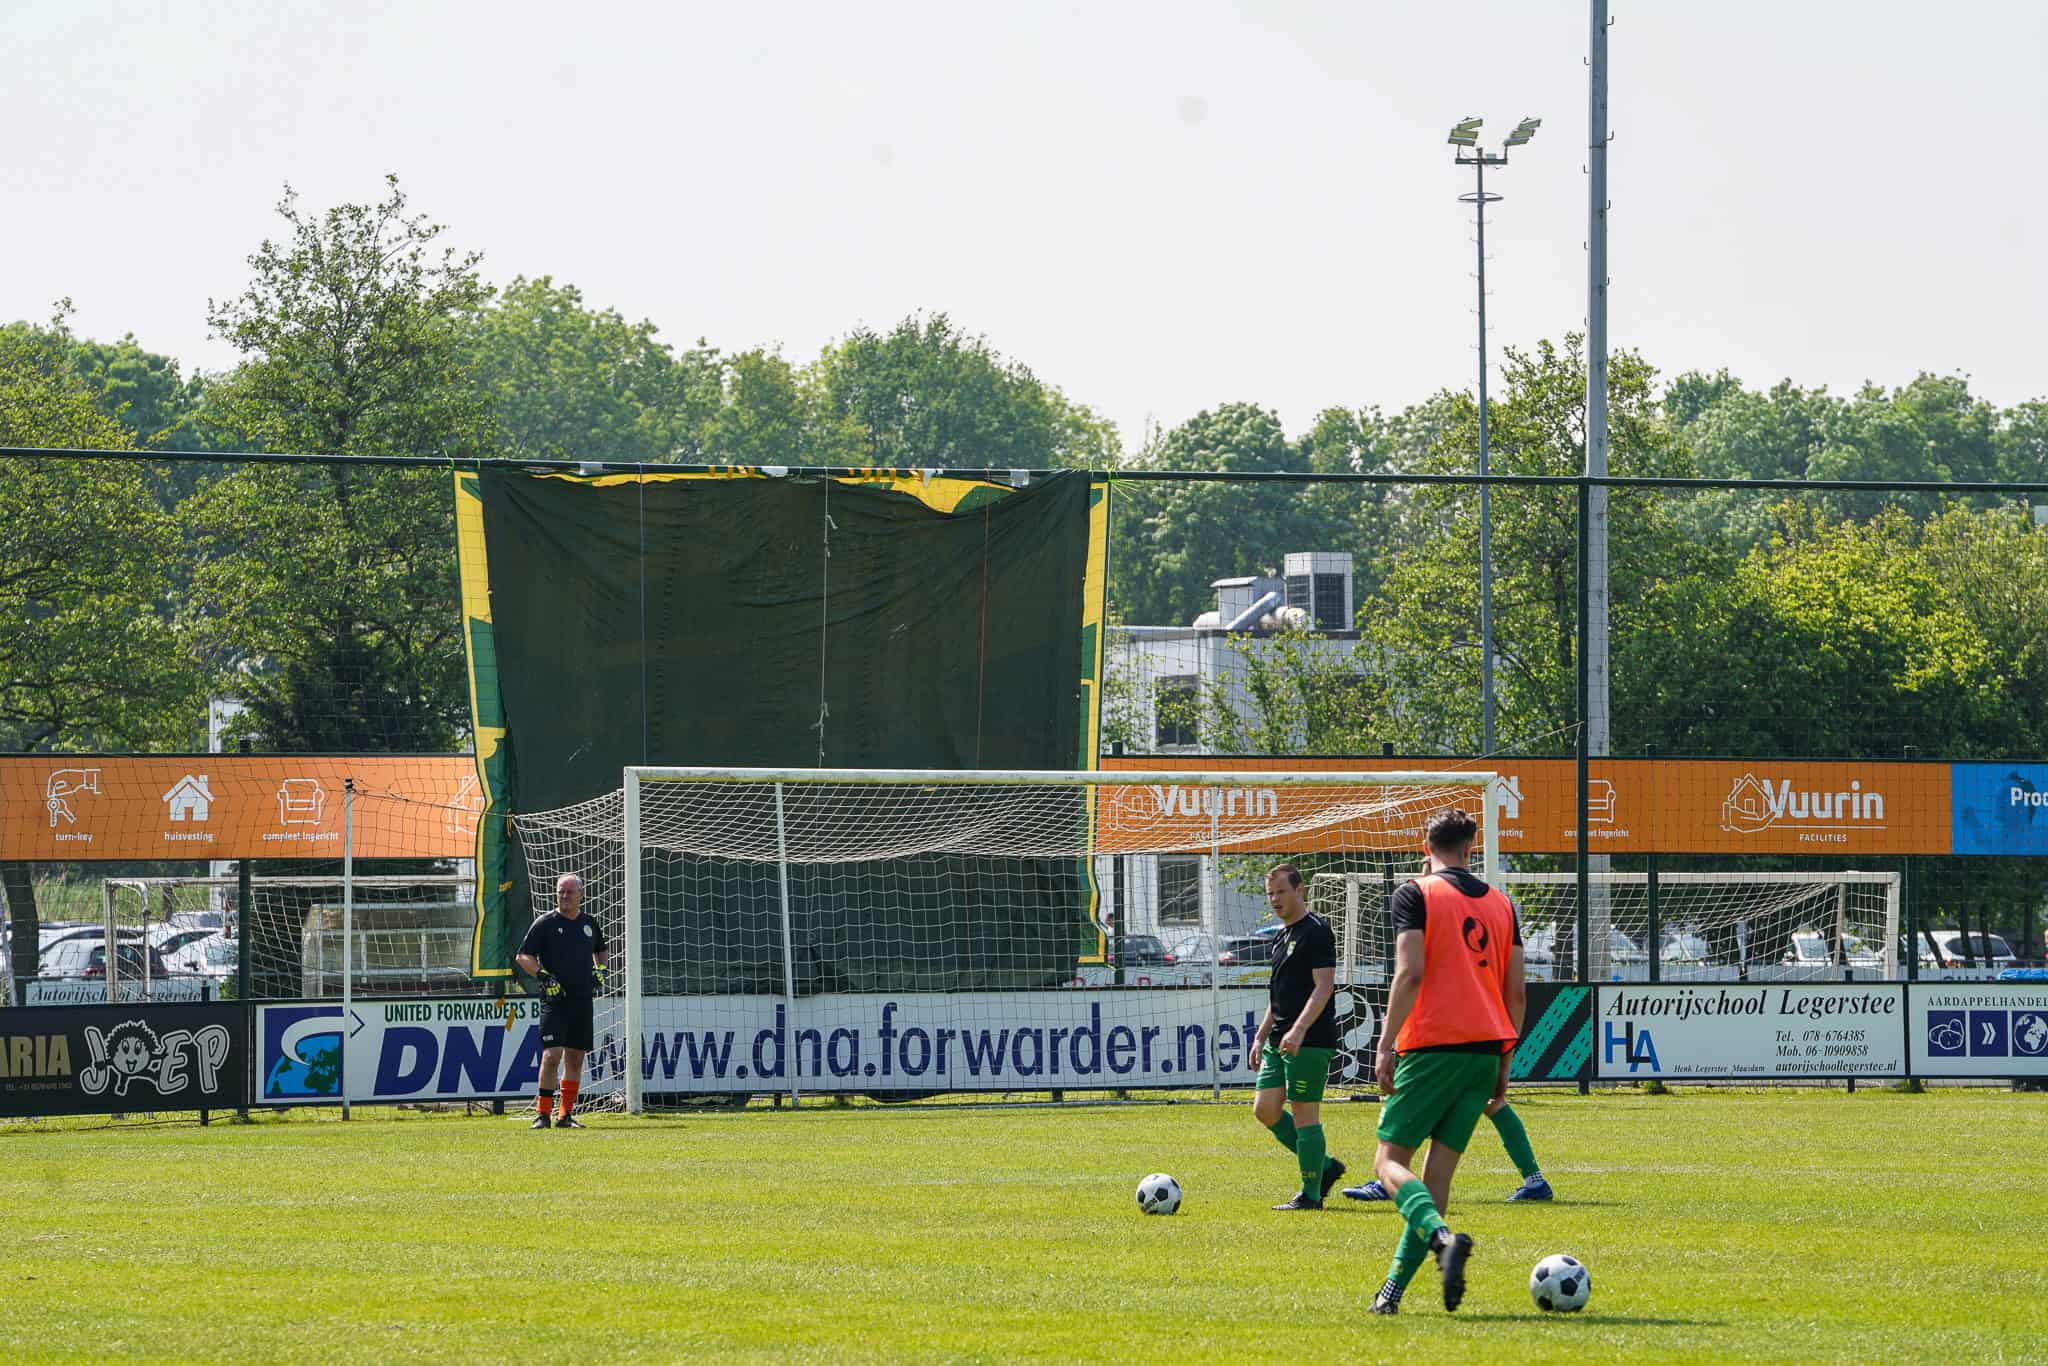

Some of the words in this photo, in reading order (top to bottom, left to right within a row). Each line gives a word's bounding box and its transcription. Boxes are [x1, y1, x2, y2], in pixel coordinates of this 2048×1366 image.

[1763, 779, 1883, 818] Vuurin
[165, 831, 214, 842] huisvesting
[1799, 833, 1848, 842] FACILITIES
[385, 1003, 432, 1022] UNITED
[437, 1001, 526, 1021] FORWARDERS
[1606, 989, 1767, 1021] Autorijschool
[1778, 989, 1896, 1019] Legerstee
[586, 1002, 1259, 1081] www.dna.forwarder.net
[1775, 1031, 1795, 1042] Tel.
[1775, 1046, 1801, 1057] Mob.
[1775, 1060, 1897, 1073] autorijschoollegerstee.nl
